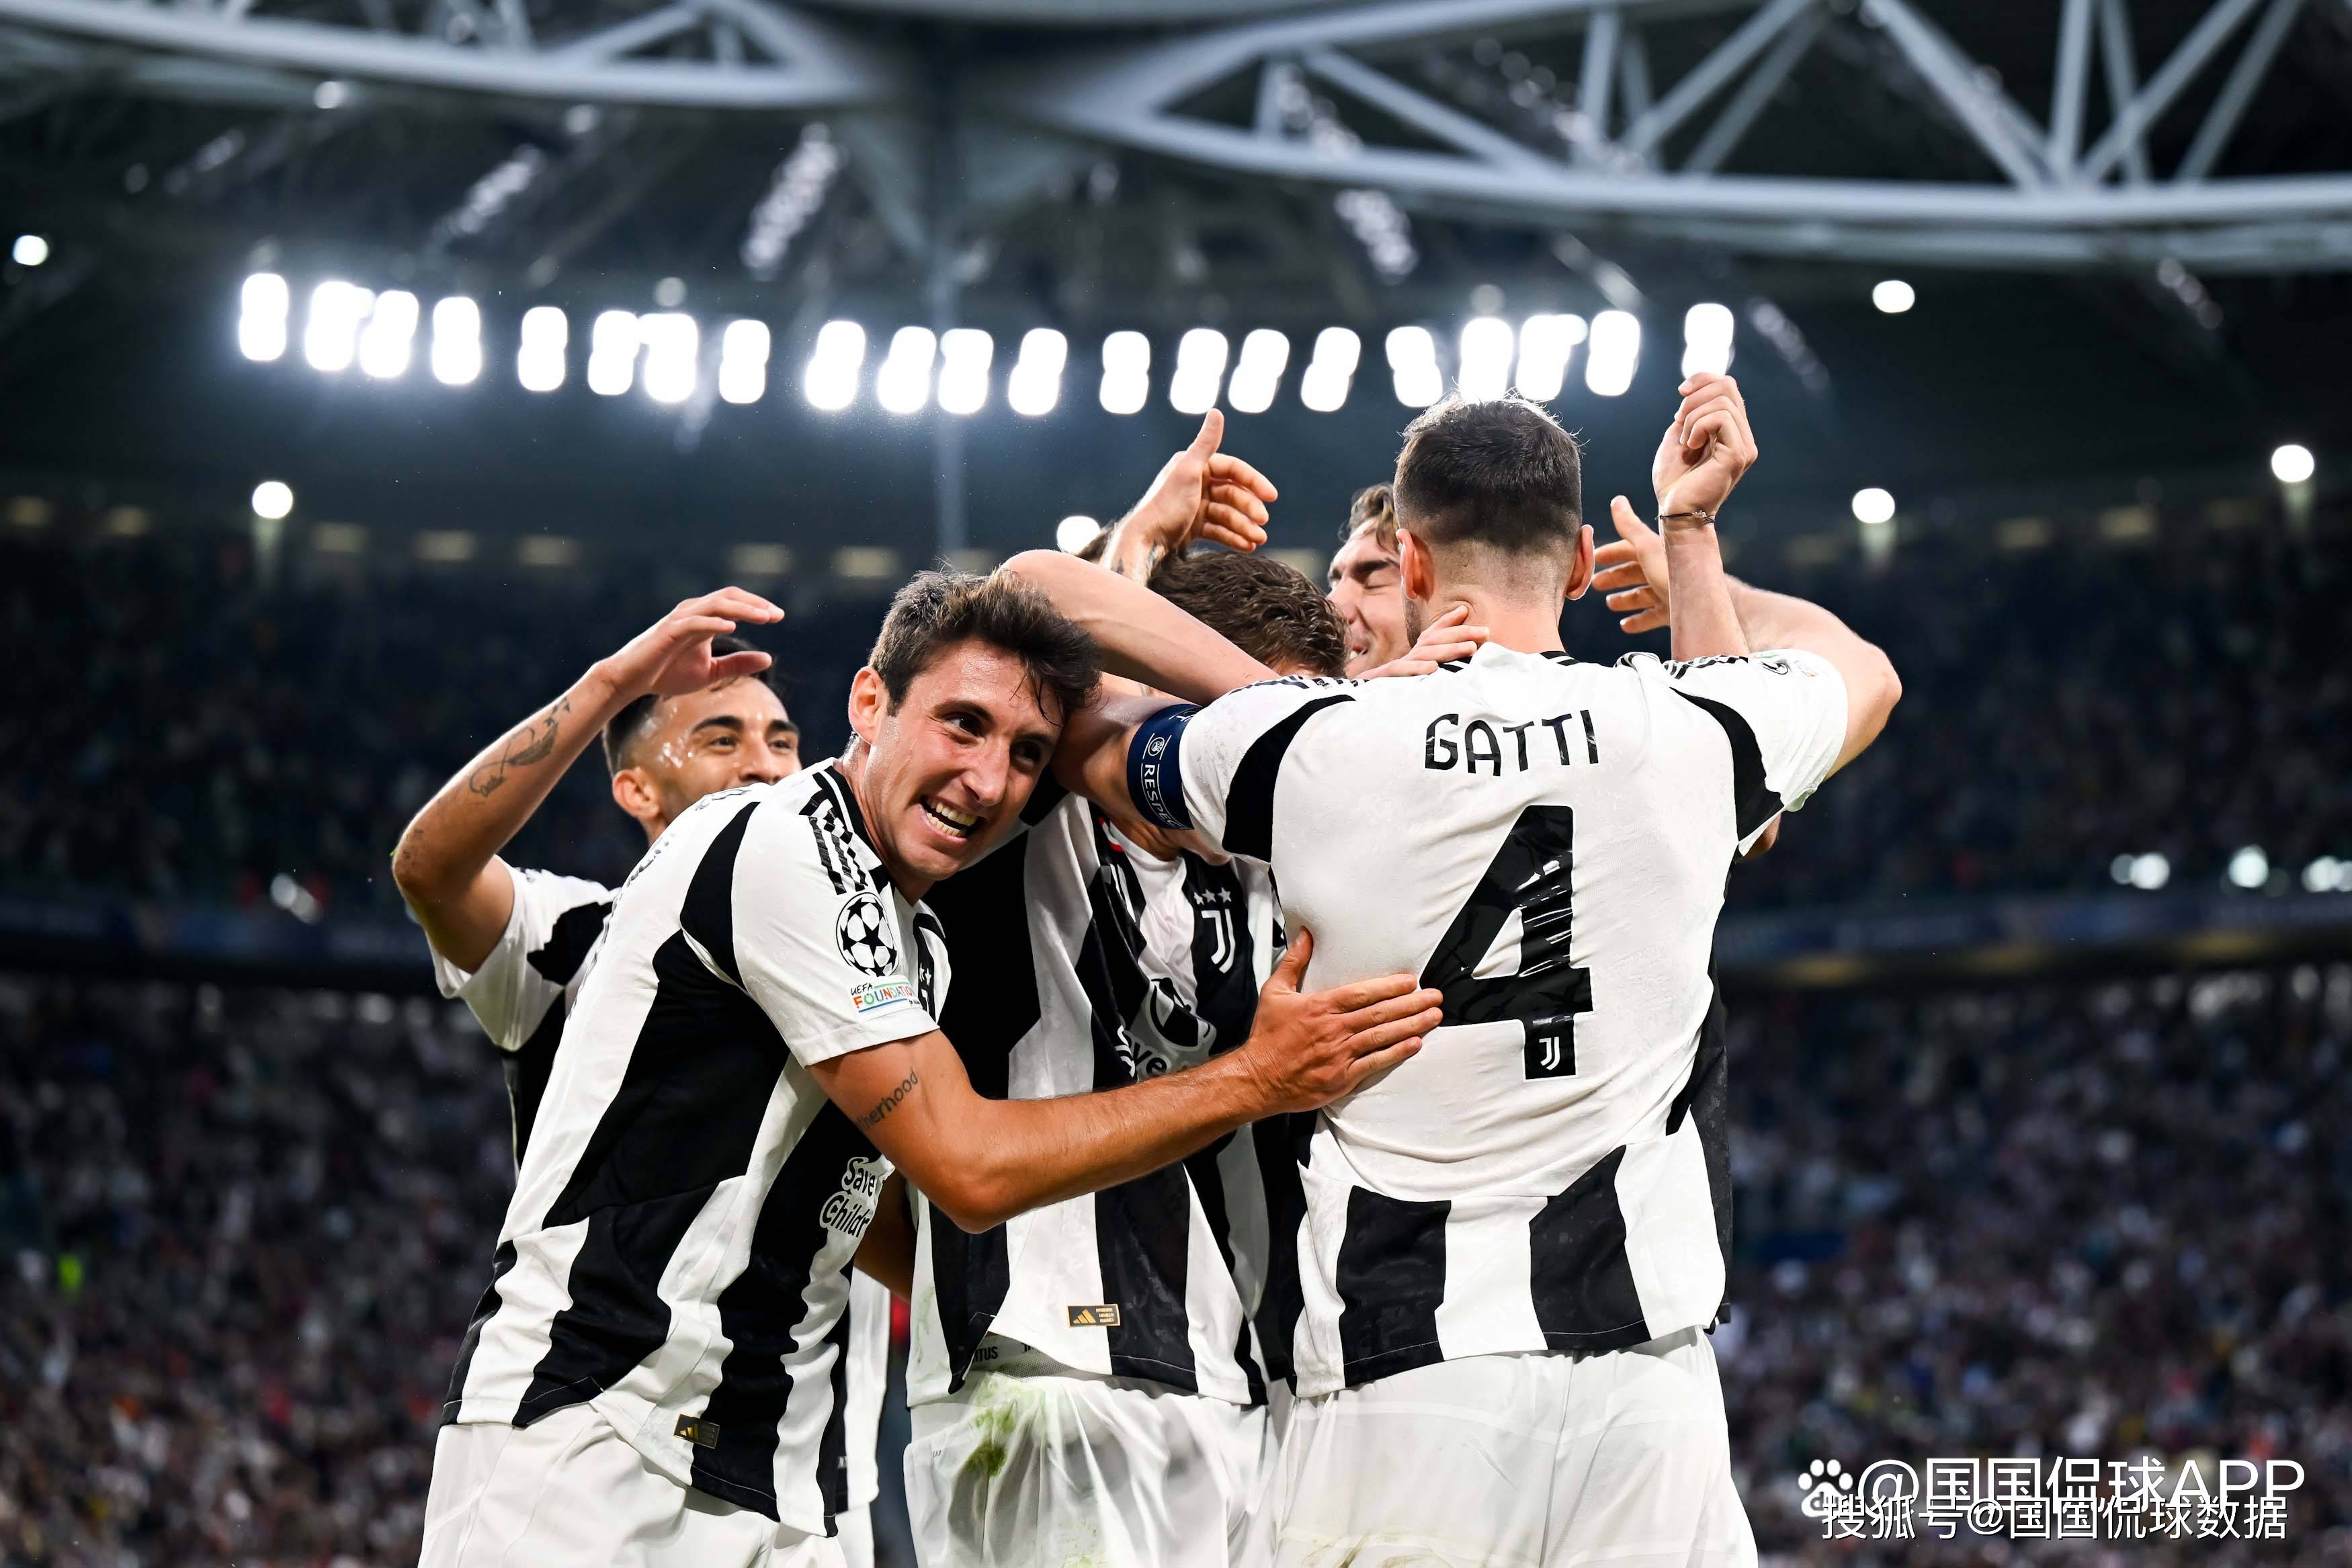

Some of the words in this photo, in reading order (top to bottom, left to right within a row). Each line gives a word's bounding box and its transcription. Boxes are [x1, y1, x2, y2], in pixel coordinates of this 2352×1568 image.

[1425, 710, 1599, 776] GATTI
[1419, 805, 1593, 1080] 4
[851, 983, 873, 996] UEFA
[853, 985, 915, 1008] FOUNDATIO
[843, 1158, 876, 1197] Save
